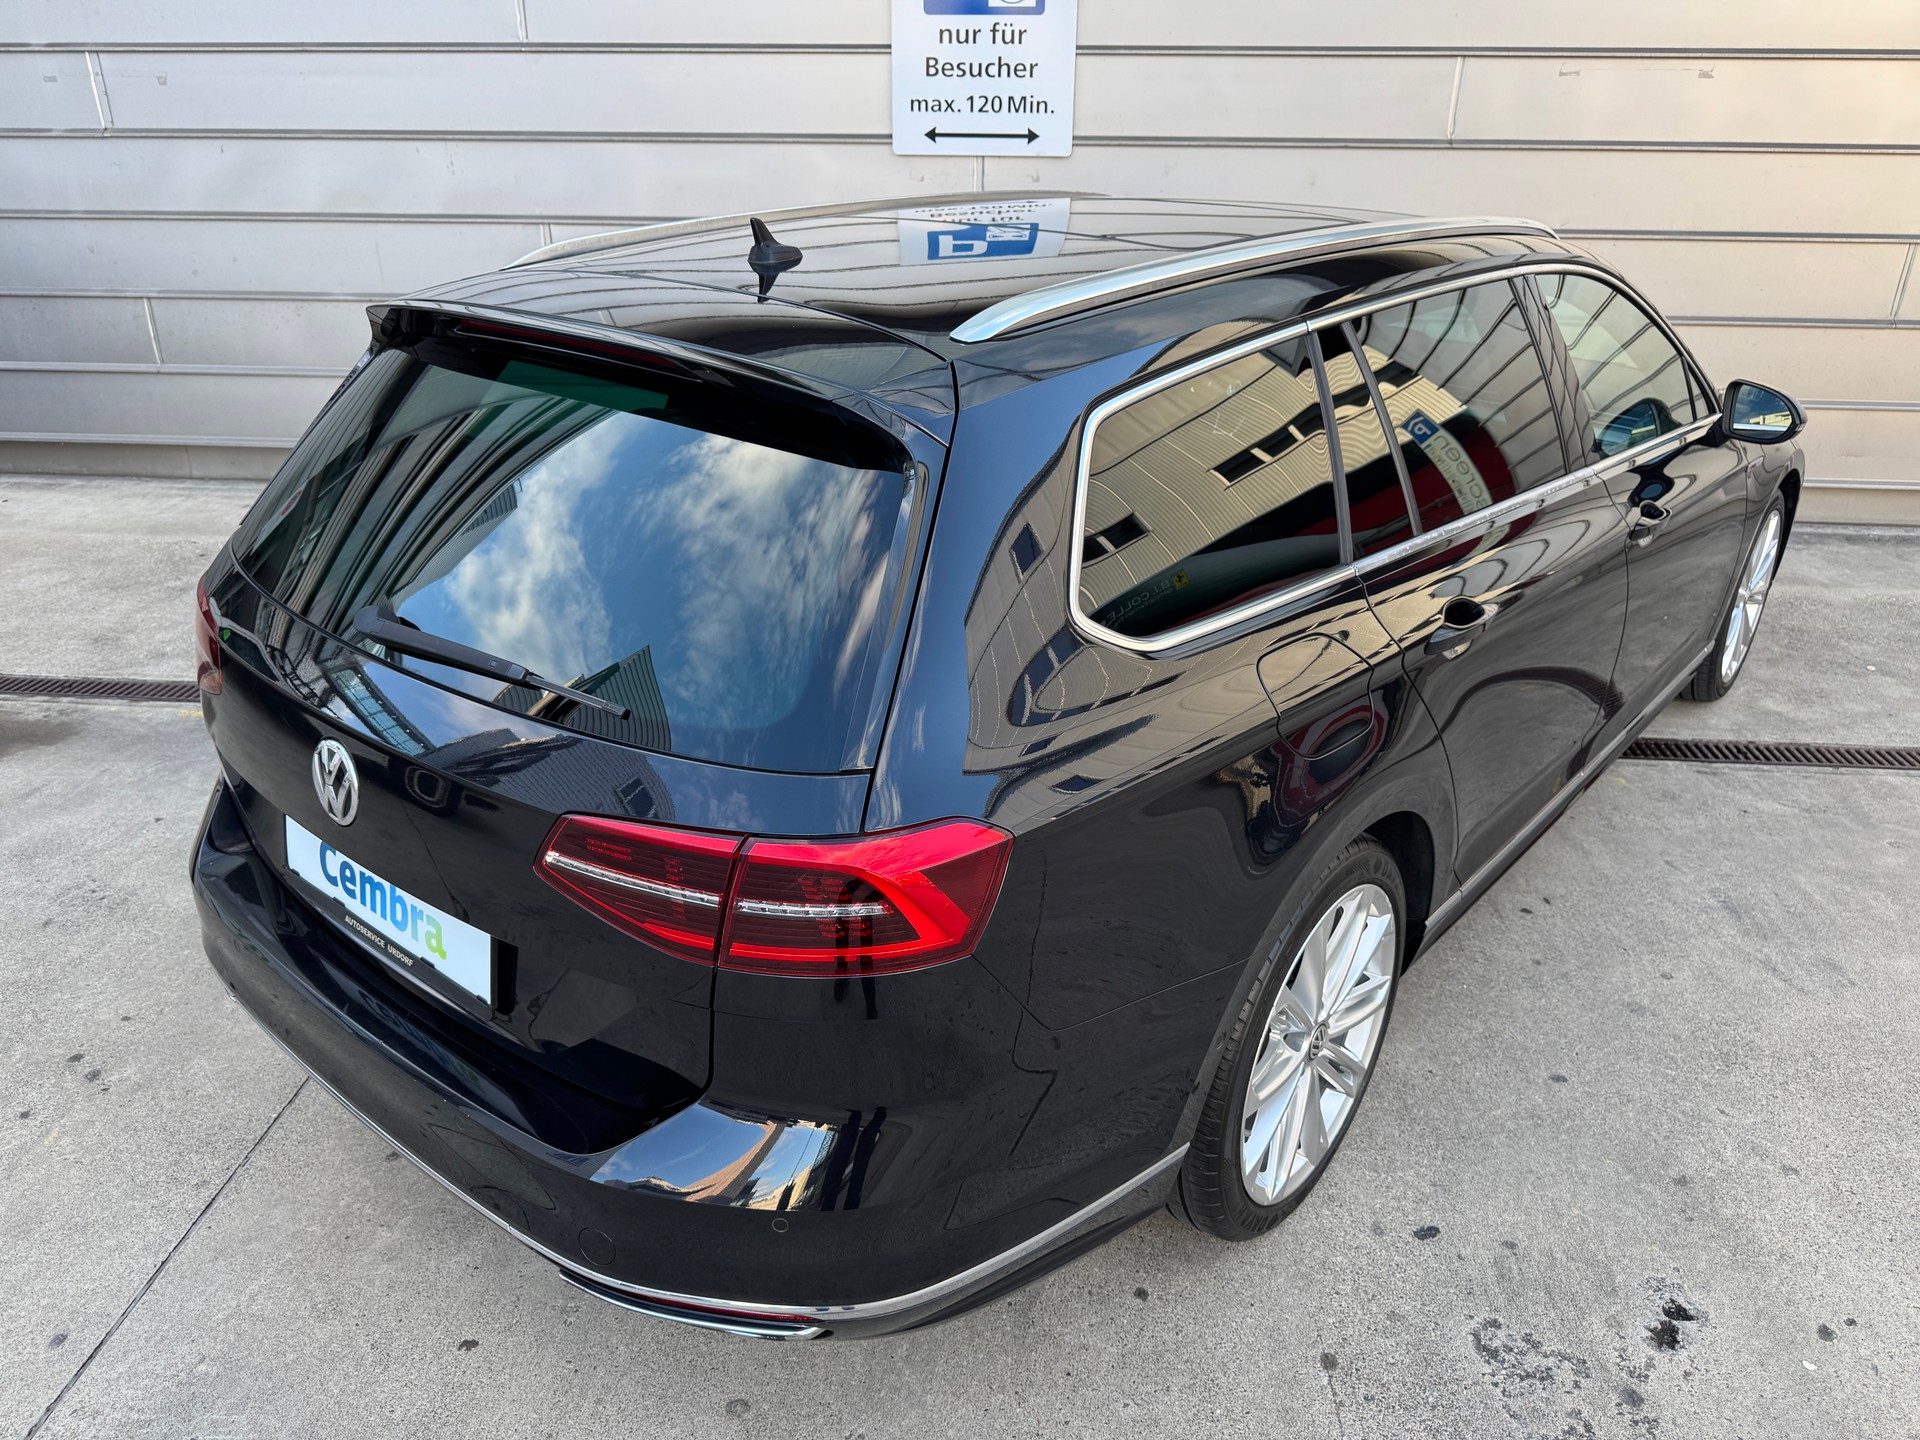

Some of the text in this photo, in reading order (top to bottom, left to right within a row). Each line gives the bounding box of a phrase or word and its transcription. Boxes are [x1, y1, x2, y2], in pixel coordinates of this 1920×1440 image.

[939, 22, 1027, 44] nur für
[926, 56, 1038, 78] Besucher
[910, 95, 1055, 114] max. 120 Min.
[319, 840, 447, 960] Cembra
[344, 915, 414, 967] AUTOSERVICE URDORF
